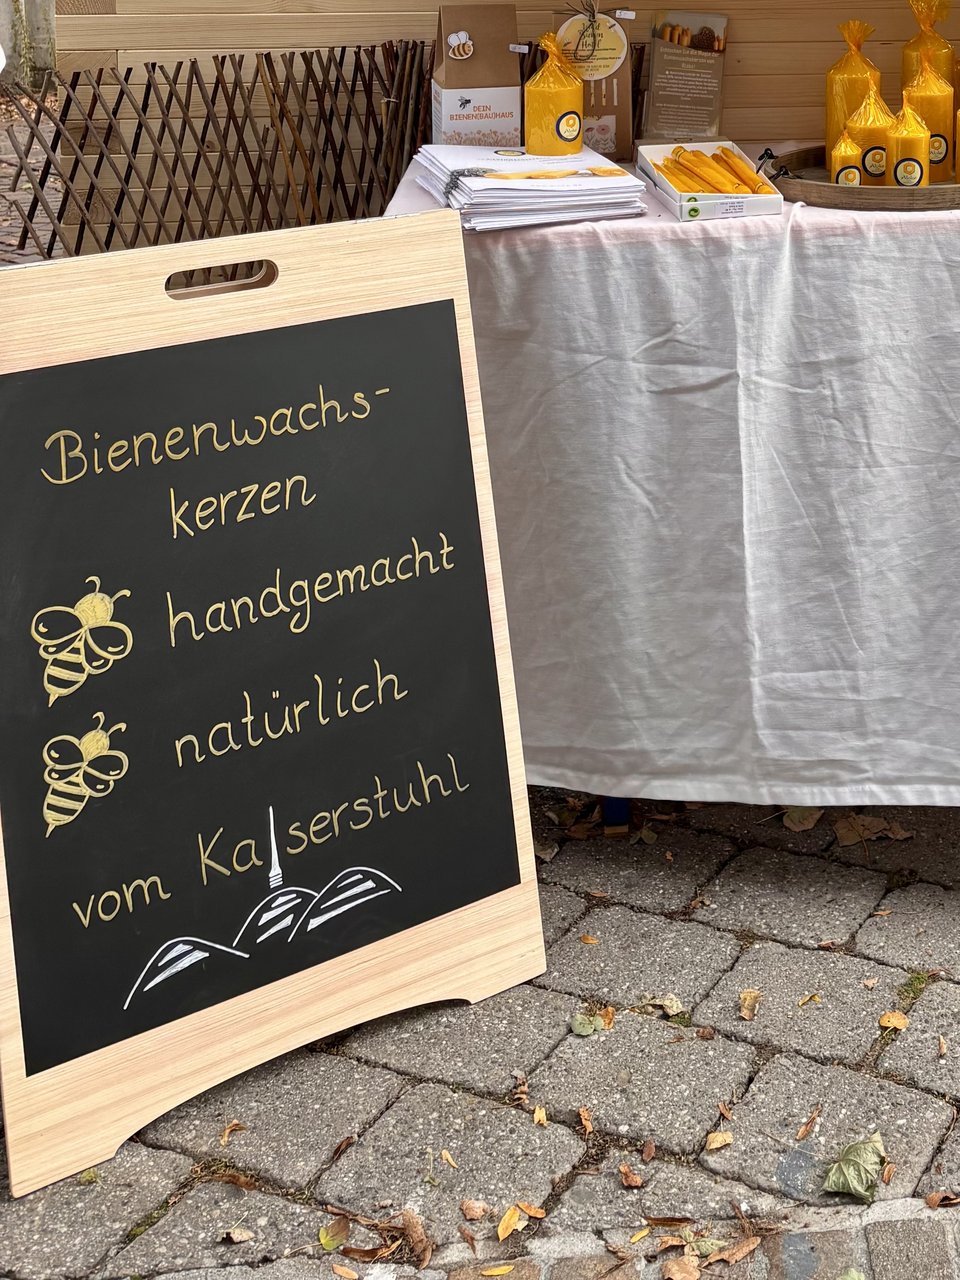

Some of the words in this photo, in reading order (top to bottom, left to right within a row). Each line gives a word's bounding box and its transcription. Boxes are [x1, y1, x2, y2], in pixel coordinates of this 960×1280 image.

[449, 111, 514, 121] BIENEN(BAU)HAUS
[473, 105, 492, 113] DEIN
[41, 383, 391, 486] Bienenwachs-
[169, 470, 317, 540] kerzen
[166, 532, 456, 649] handgemacht
[174, 658, 409, 768] natürlich
[72, 875, 172, 930] vom
